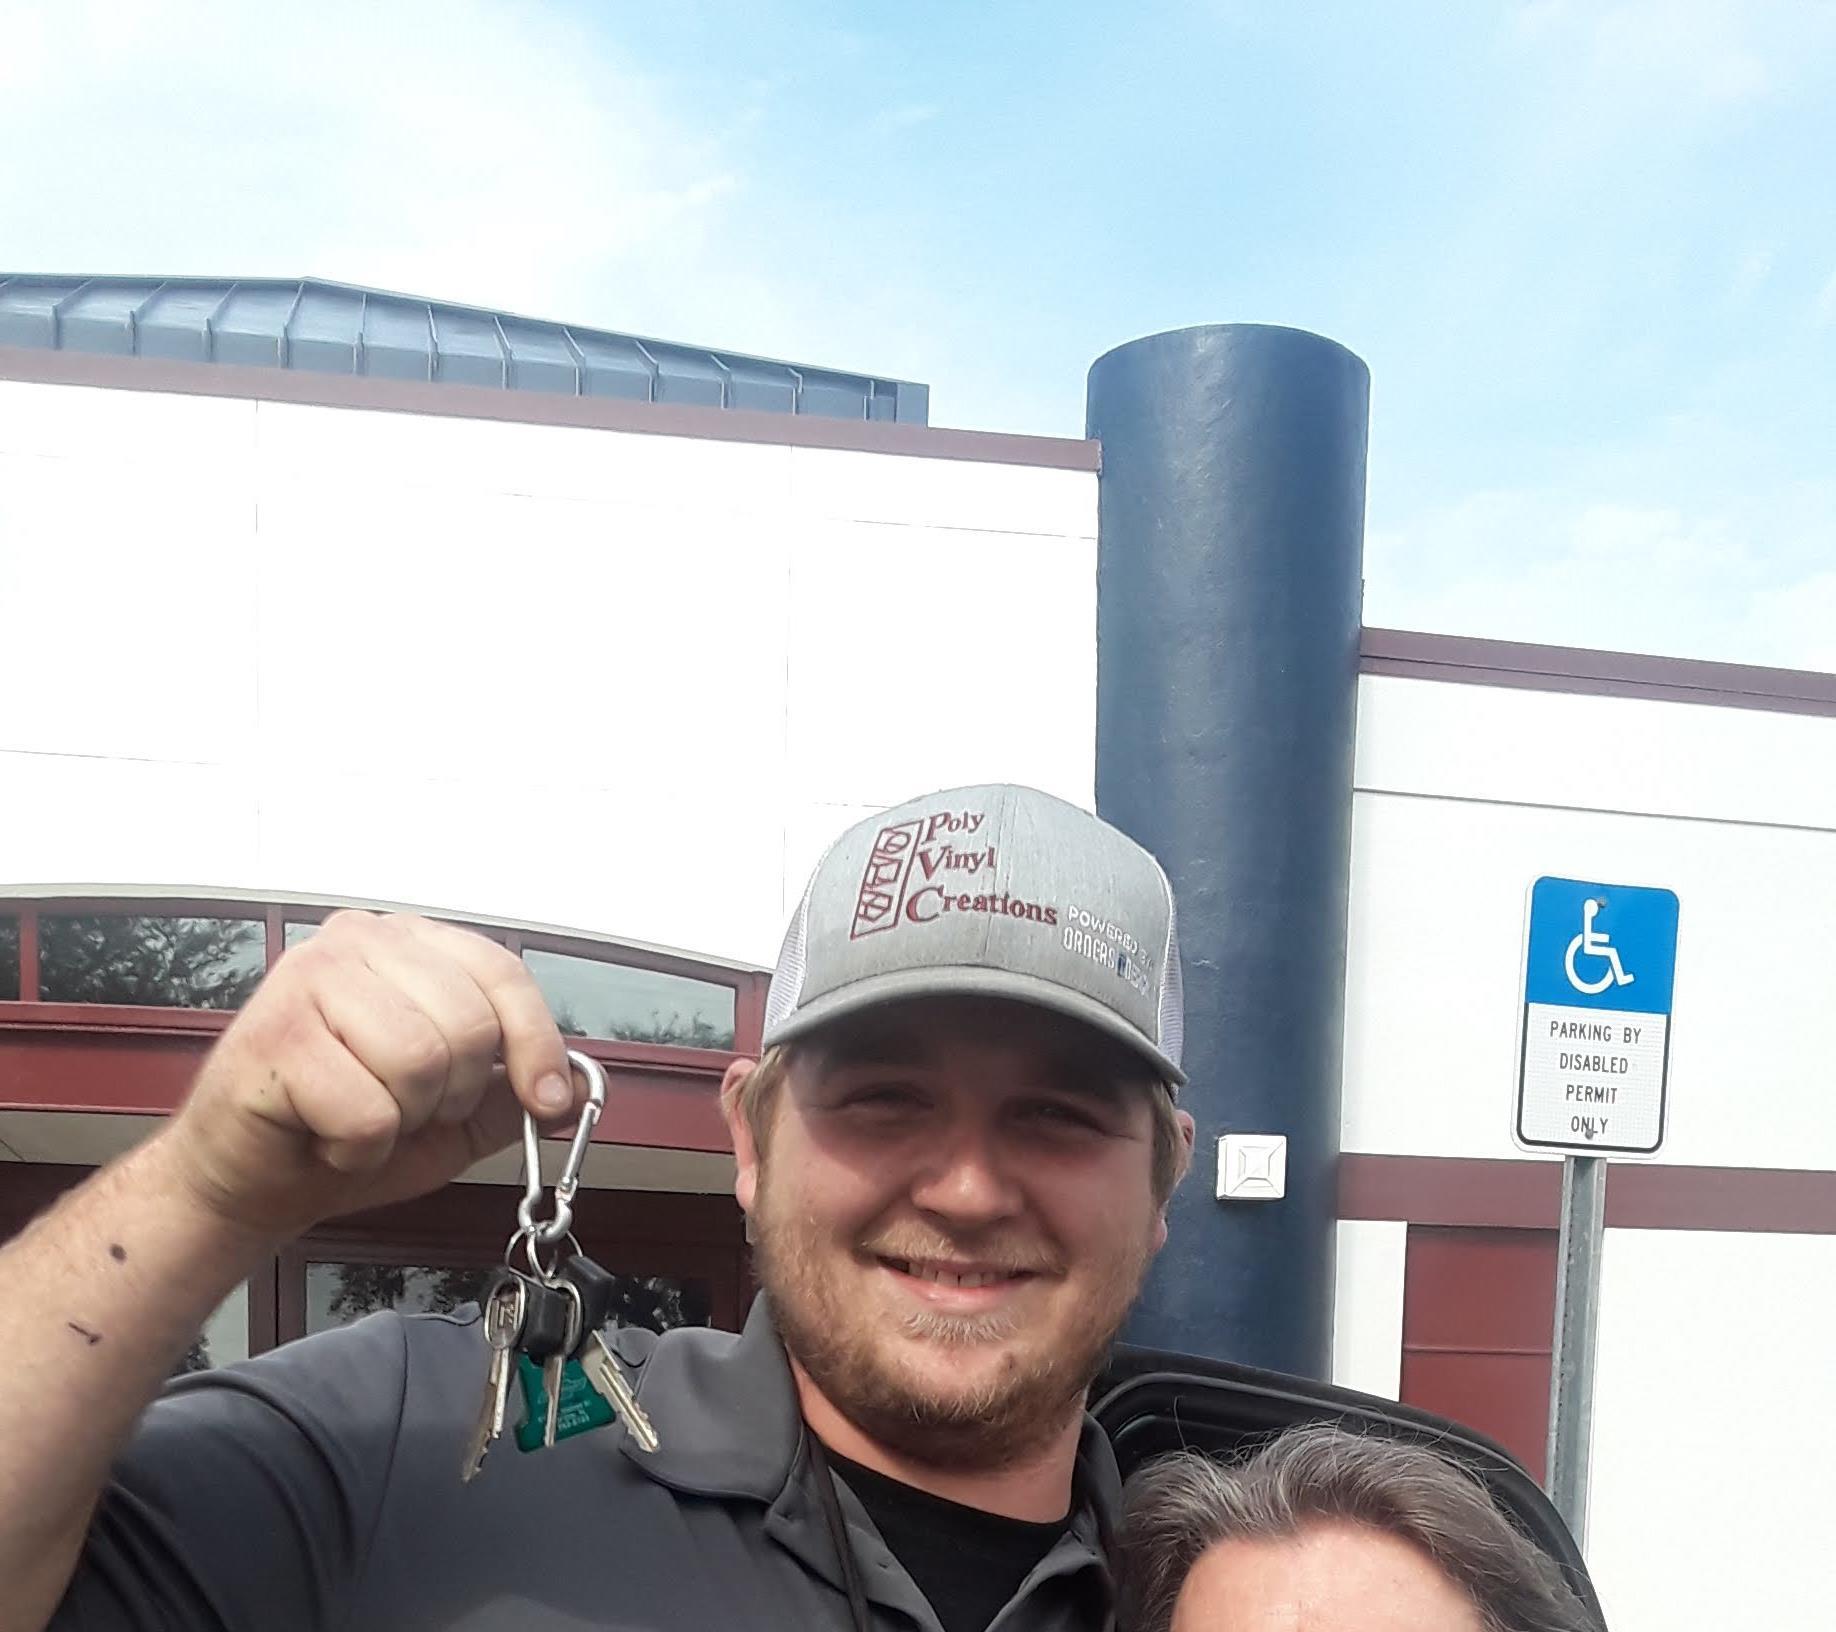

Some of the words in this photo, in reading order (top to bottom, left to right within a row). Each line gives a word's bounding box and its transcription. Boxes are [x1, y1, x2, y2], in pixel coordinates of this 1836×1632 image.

[921, 811, 985, 845] Poly
[918, 846, 996, 881] Vinyl
[905, 884, 1058, 926] Creations
[1550, 1020, 1612, 1043] PARKING
[1623, 1026, 1642, 1044] BY
[1559, 1052, 1629, 1074] DISABLED
[1565, 1084, 1618, 1105] PERMIT
[1570, 1115, 1609, 1135] ONLY
